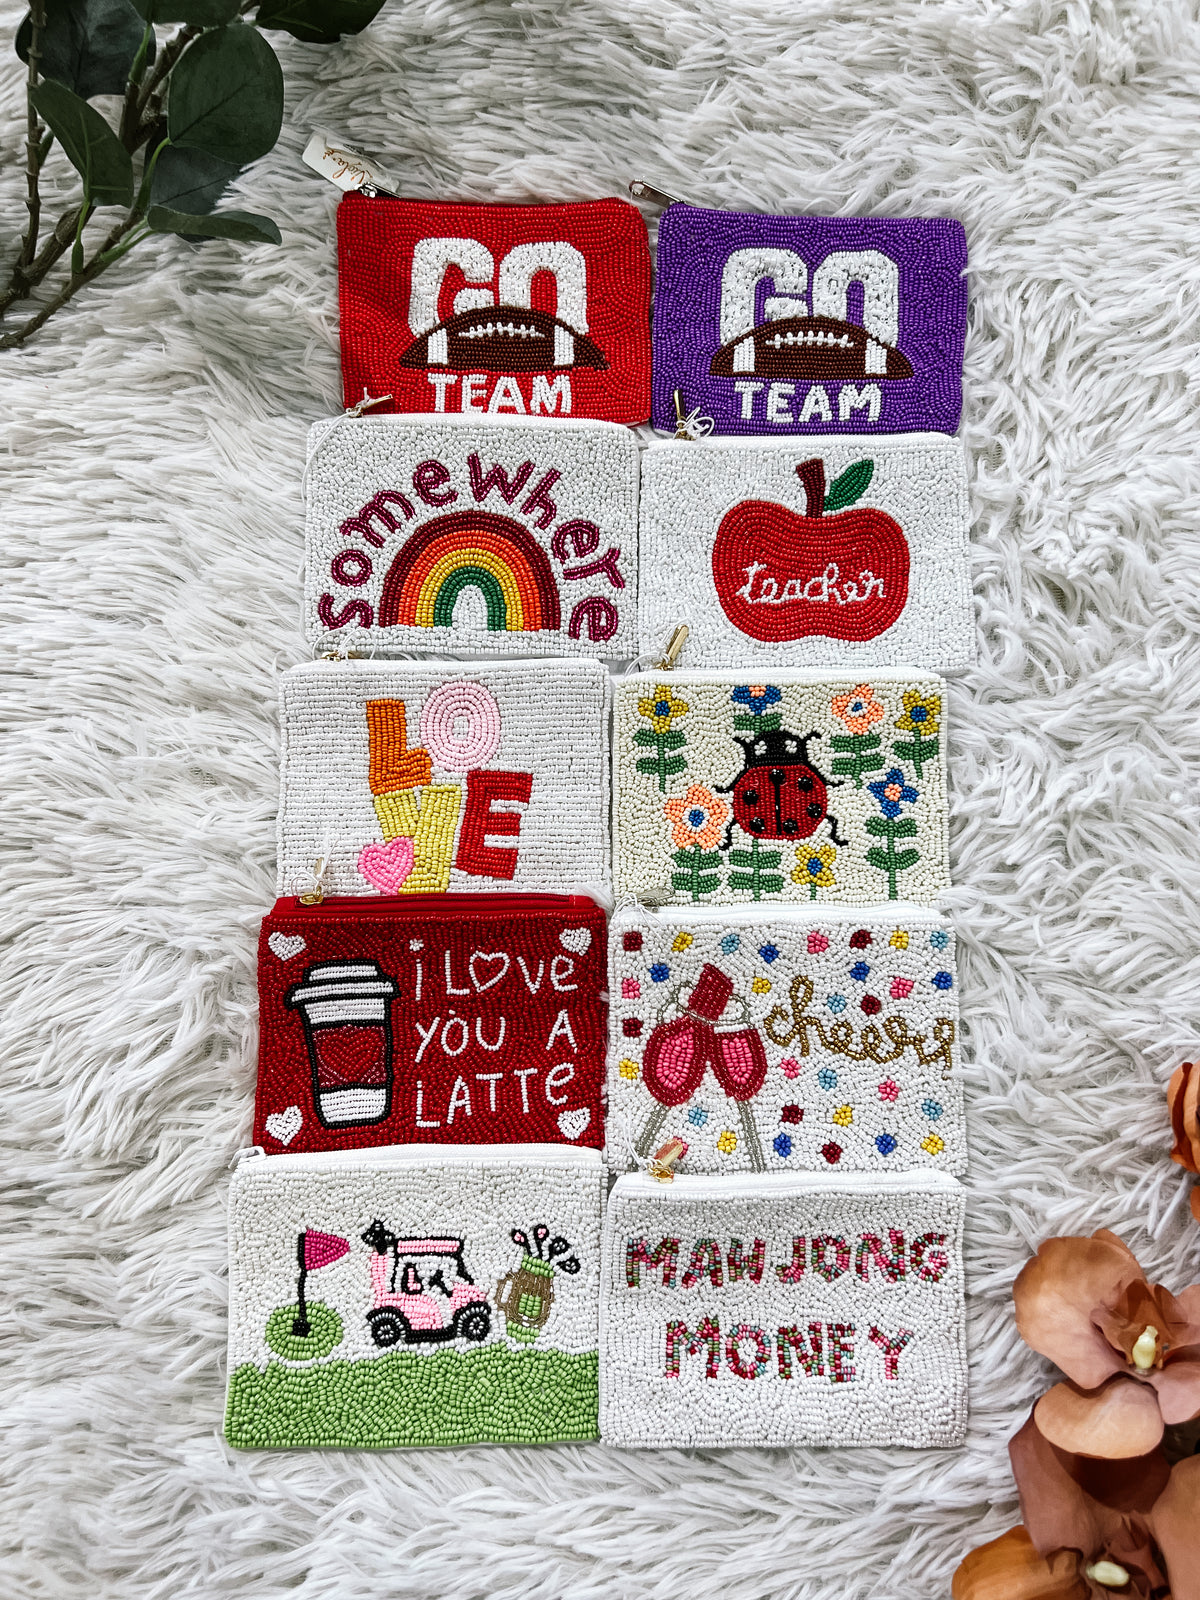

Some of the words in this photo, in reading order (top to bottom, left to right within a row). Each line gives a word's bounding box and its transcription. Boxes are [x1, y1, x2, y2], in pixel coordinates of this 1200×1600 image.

[408, 237, 589, 338] GO
[720, 247, 899, 348] GO
[427, 373, 572, 414] TEAM
[734, 381, 881, 423] TEAM
[318, 452, 625, 641] somewhere
[735, 561, 887, 604] teacher
[409, 939, 424, 1000] i
[546, 1009, 577, 1053] A
[763, 976, 954, 1080] cheers
[626, 1228, 948, 1289] MAHJONG
[665, 1317, 914, 1382] MONEY
